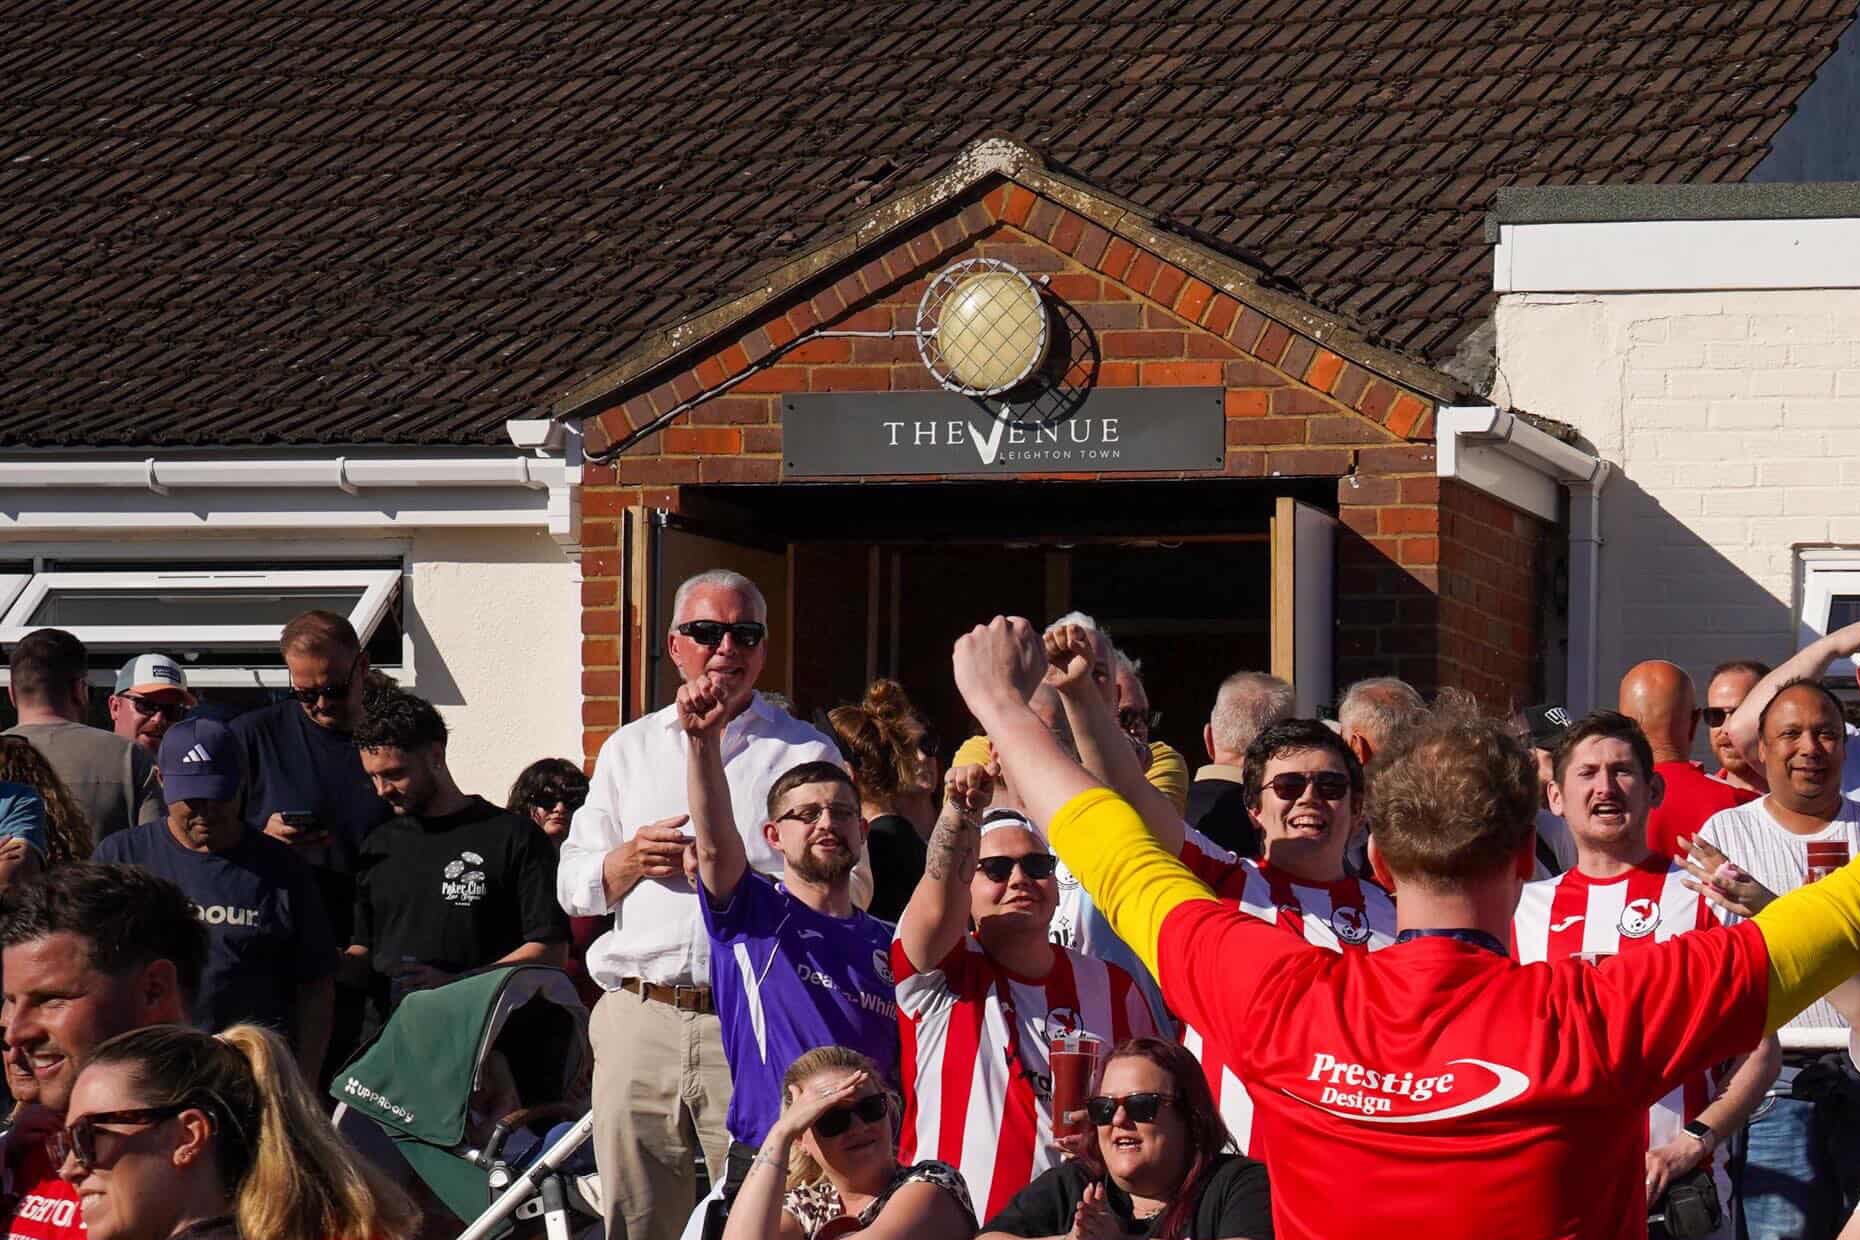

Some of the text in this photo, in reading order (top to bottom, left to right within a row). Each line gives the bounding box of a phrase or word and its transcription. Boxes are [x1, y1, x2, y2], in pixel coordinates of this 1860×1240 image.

[883, 402, 1120, 465] THE VENUE
[1000, 450, 1120, 460] LEIGHTON TOWN
[1307, 1053, 1455, 1101] Prestige
[1320, 1087, 1392, 1114] Design
